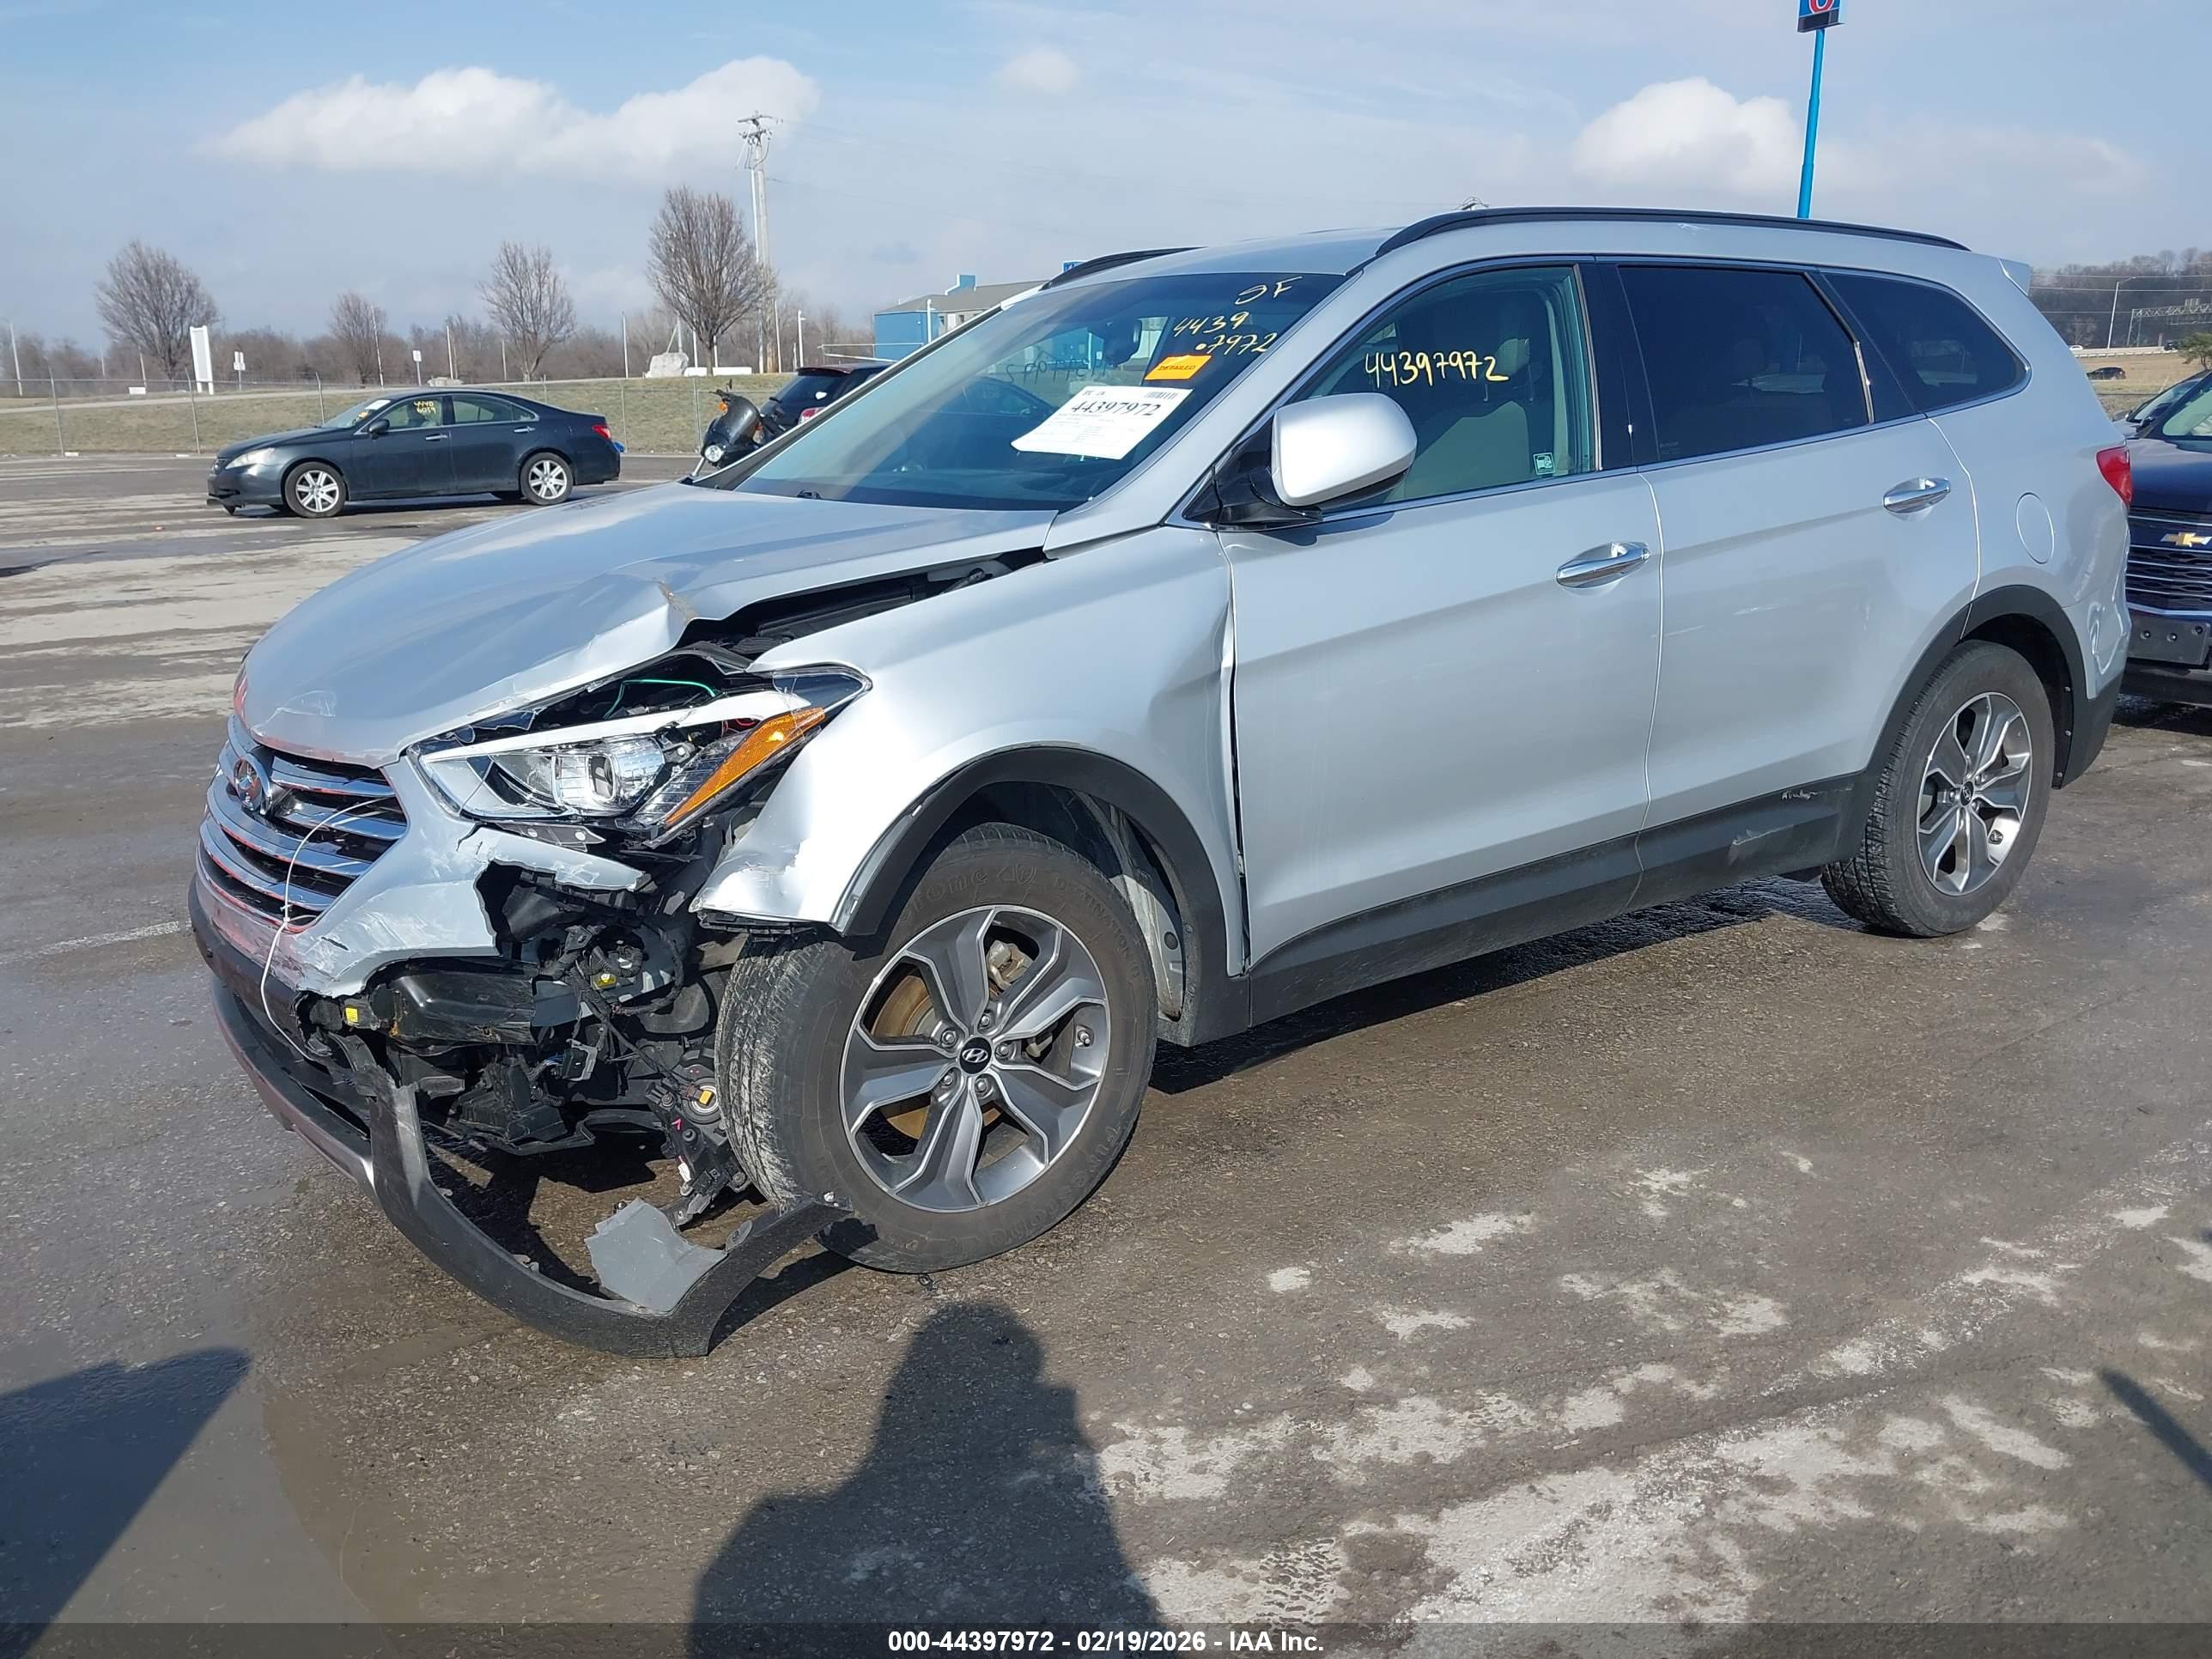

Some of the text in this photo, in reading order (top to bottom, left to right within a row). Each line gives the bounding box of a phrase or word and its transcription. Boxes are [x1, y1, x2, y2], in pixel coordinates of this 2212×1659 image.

[1173, 311, 1250, 337] 4439
[1364, 350, 1510, 388] 44397972
[1071, 401, 1162, 416] 44397972
